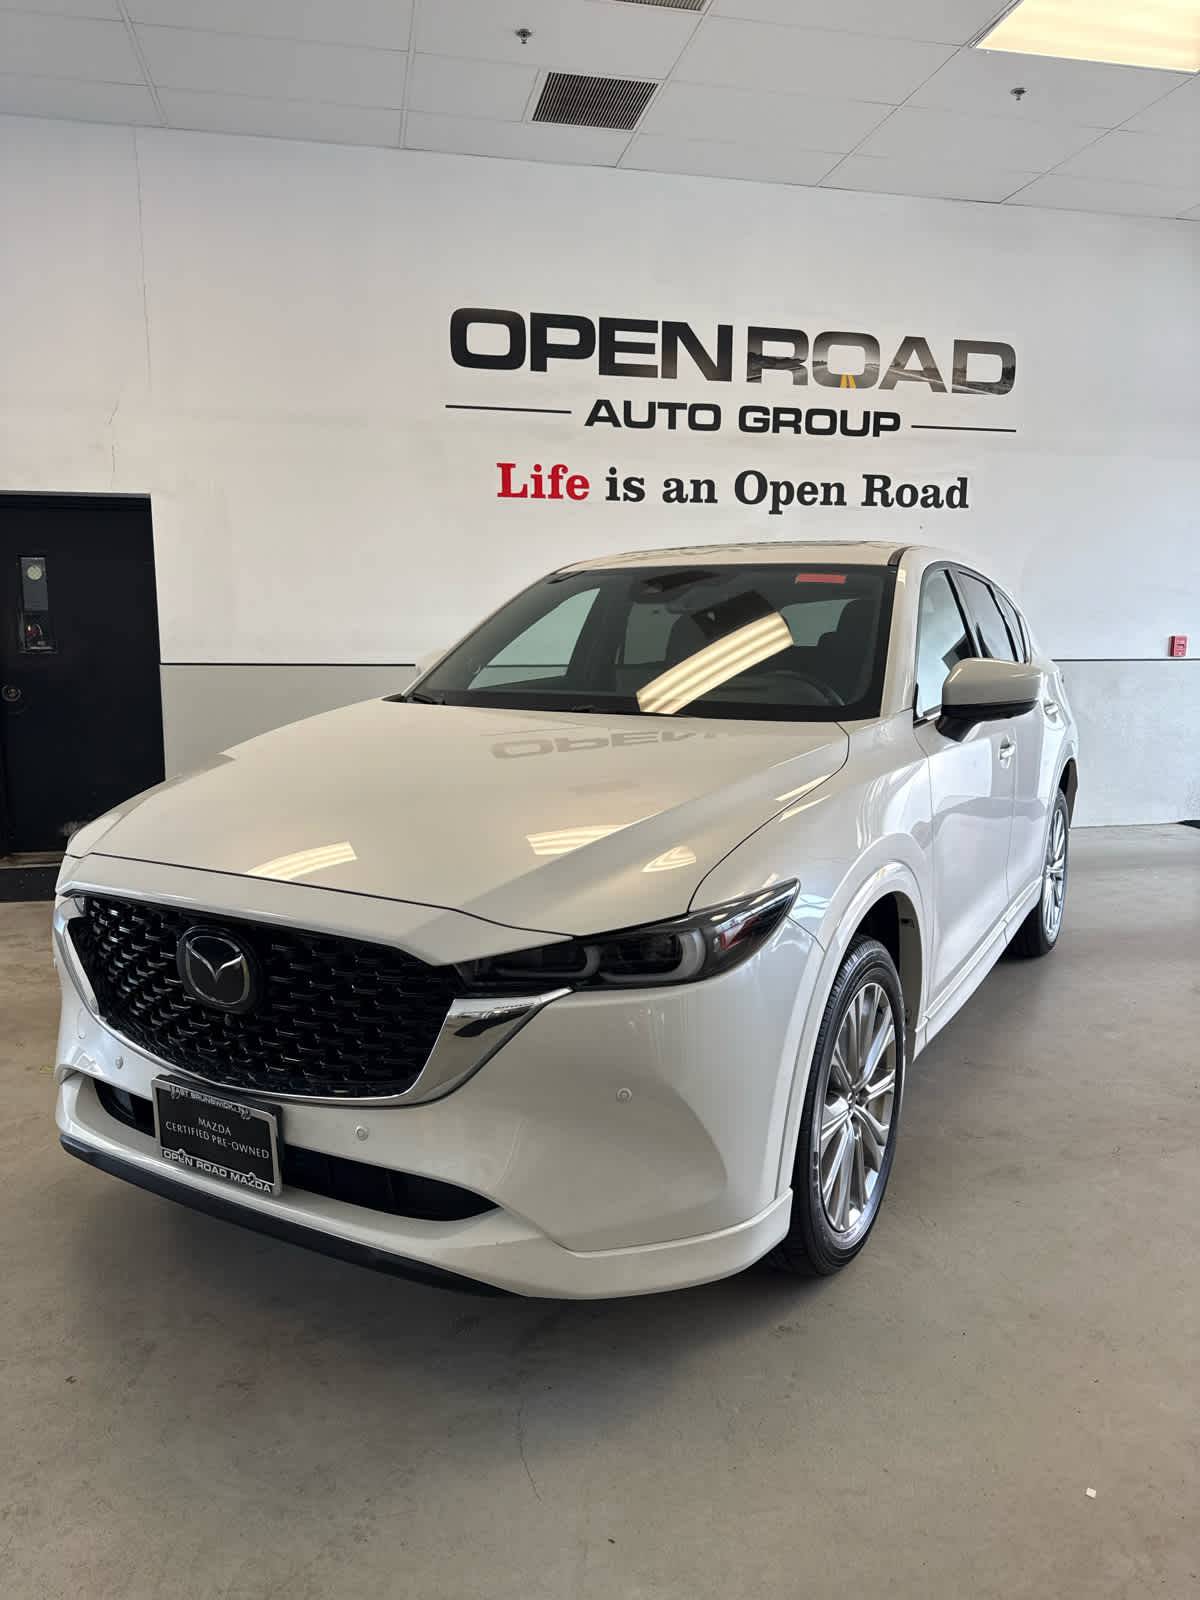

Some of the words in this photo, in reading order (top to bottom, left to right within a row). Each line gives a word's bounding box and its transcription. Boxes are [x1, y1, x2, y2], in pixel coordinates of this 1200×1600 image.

[450, 307, 733, 382] OPEN
[746, 326, 1017, 396] ROAD
[584, 399, 722, 432] AUTO
[738, 406, 901, 438] GROUP
[496, 463, 590, 500] Life
[605, 467, 645, 502] is
[662, 477, 718, 503] an
[734, 470, 847, 515] Open
[861, 474, 969, 509] Road
[165, 1120, 210, 1141] CERTIFIED
[212, 1134, 270, 1160] PRE-OWNED
[198, 1117, 232, 1137] MAZDA
[163, 1149, 193, 1167] OPEN
[196, 1160, 228, 1178] ROAD
[230, 1171, 271, 1193] MAZDA
